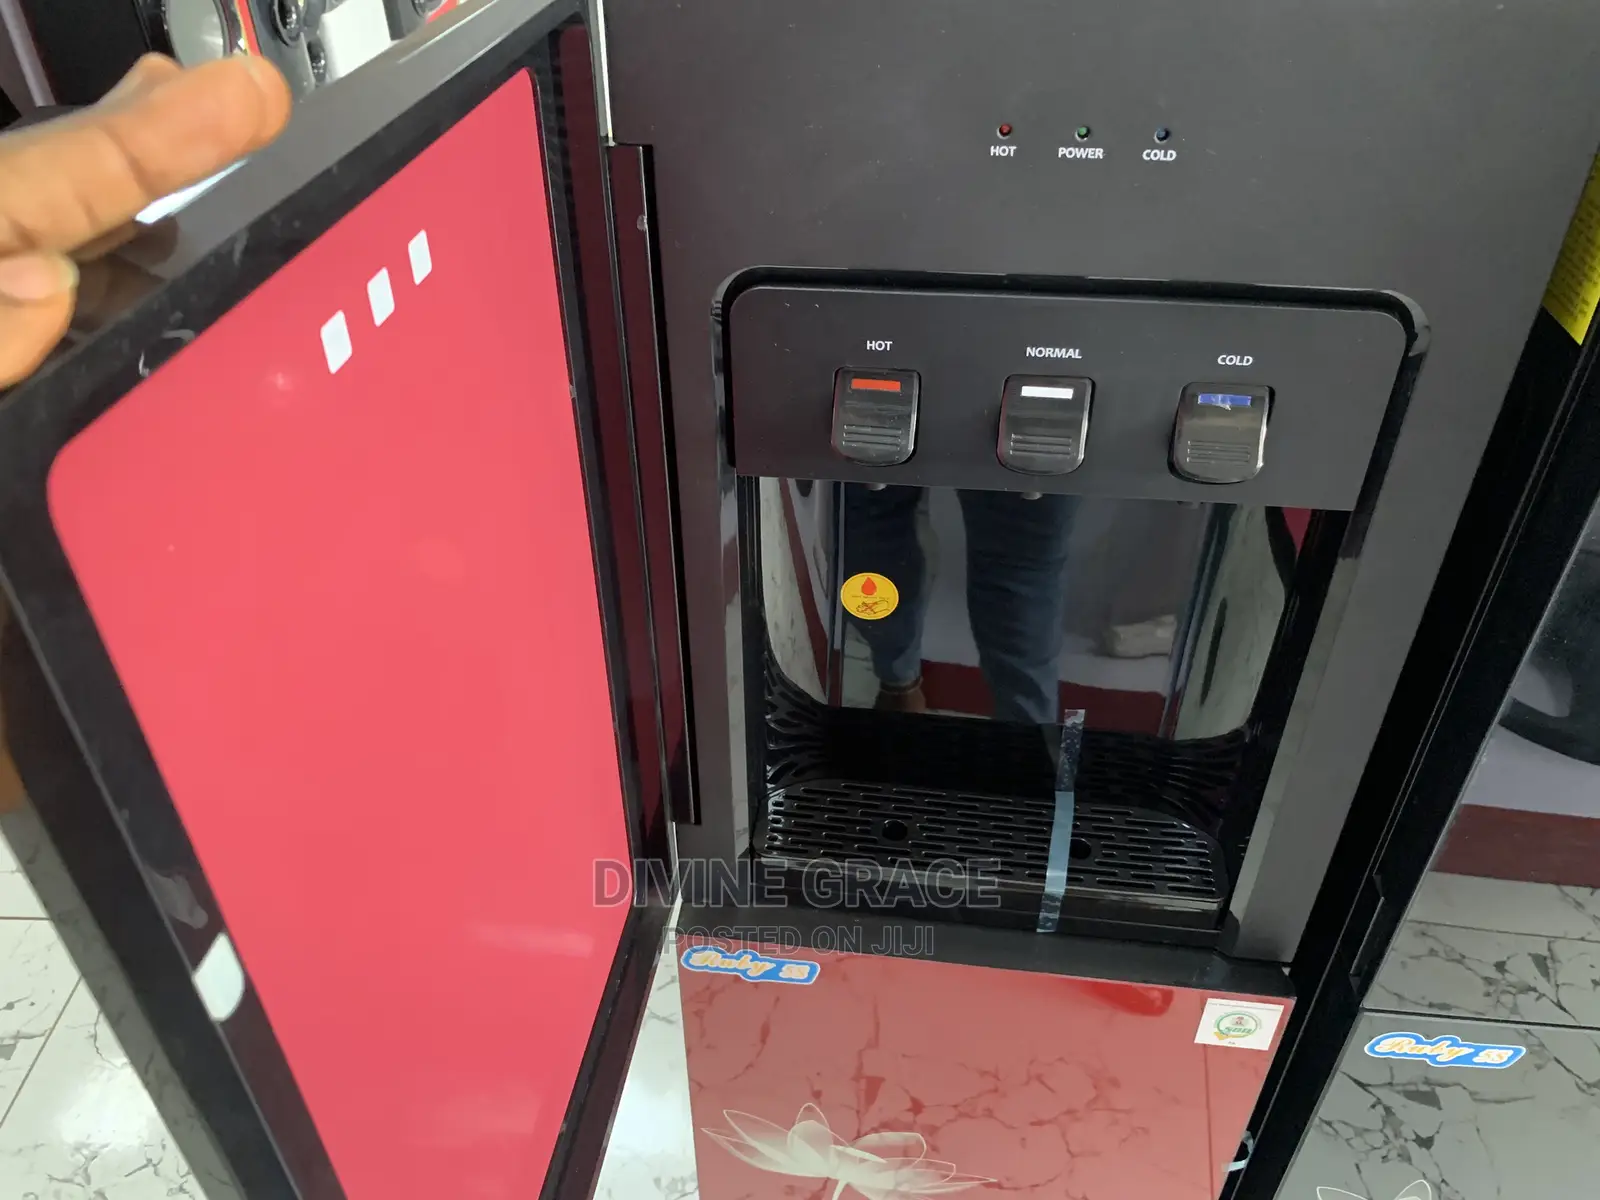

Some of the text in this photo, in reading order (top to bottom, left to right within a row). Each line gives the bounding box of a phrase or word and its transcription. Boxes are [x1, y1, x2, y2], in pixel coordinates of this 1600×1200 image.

[990, 145, 1017, 157] HOT
[1058, 147, 1104, 160] POWER
[1142, 149, 1177, 162] COLD
[865, 339, 893, 352] HOT
[1025, 346, 1082, 360] NORMAL
[1217, 354, 1253, 367] COLD
[1374, 1037, 1476, 1062] Ruby
